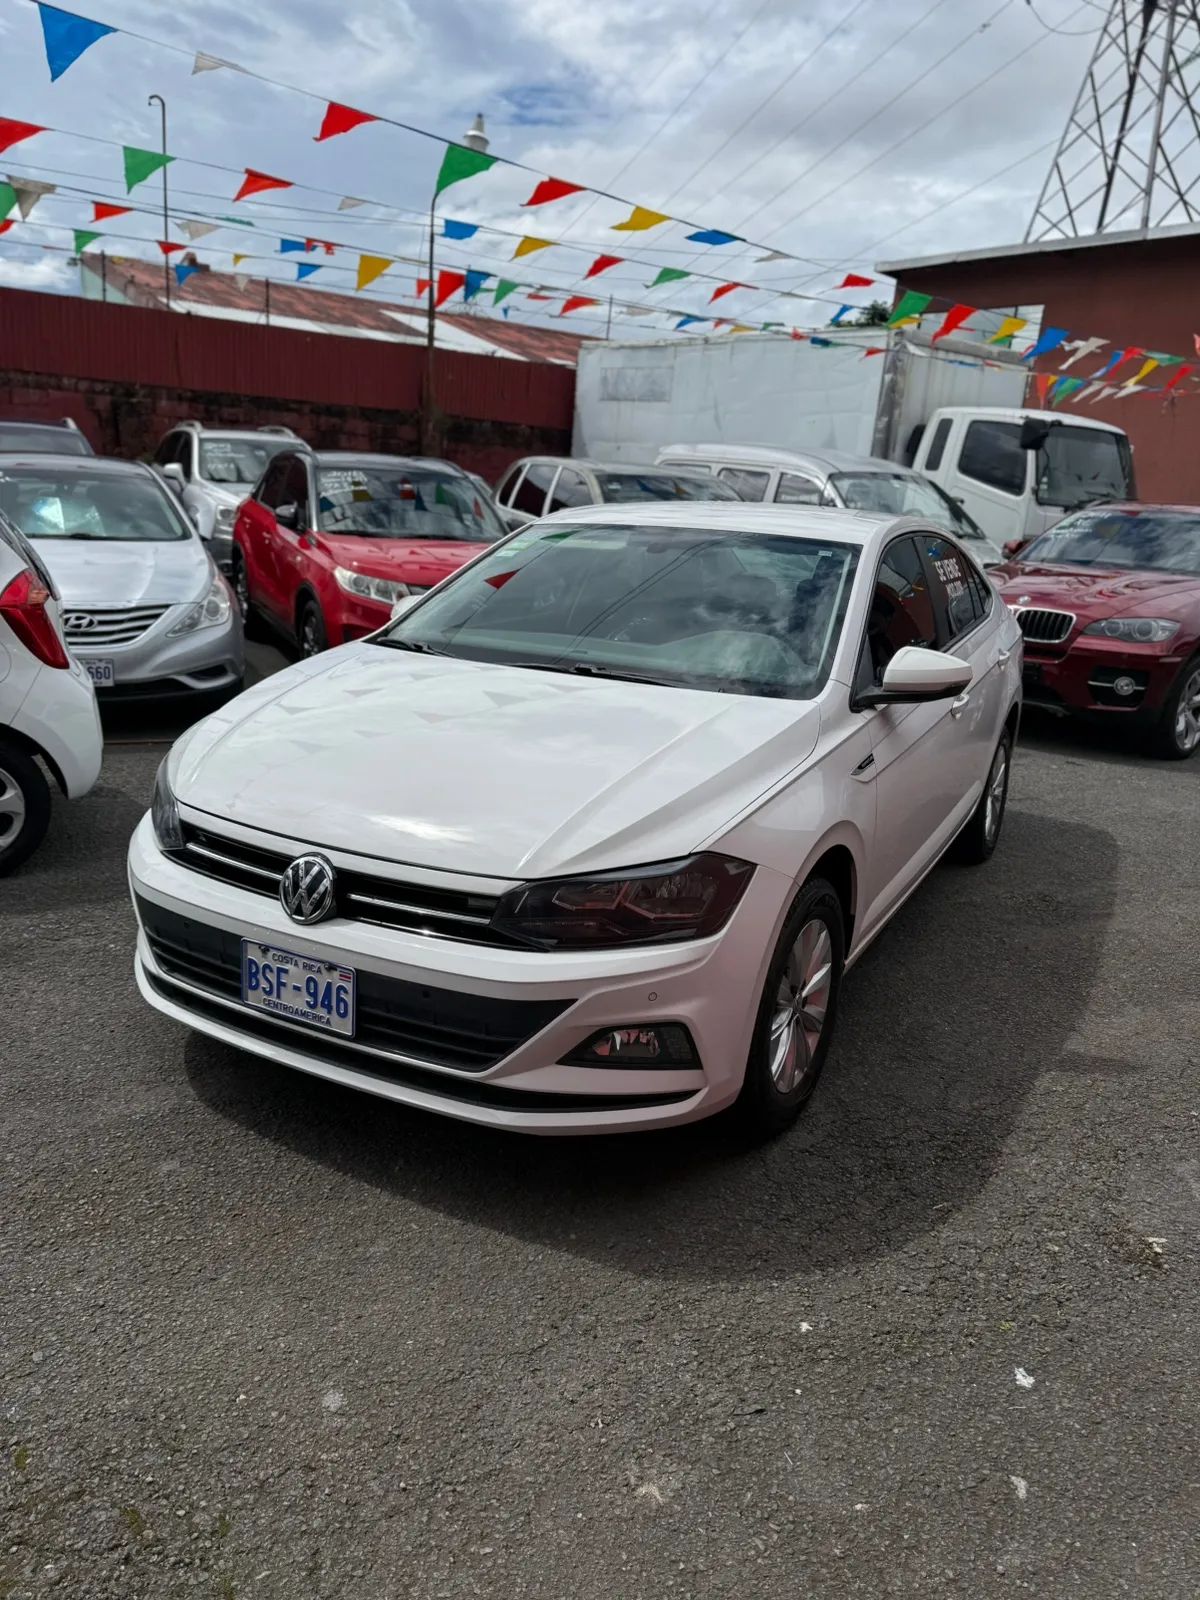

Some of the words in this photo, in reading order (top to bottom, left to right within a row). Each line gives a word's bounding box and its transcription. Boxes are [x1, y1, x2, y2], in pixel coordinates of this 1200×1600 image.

[272, 952, 300, 968] COSTA
[302, 961, 323, 975] RICA
[247, 955, 349, 1019] BSF-946
[262, 997, 332, 1026] CENTROAMERICA
